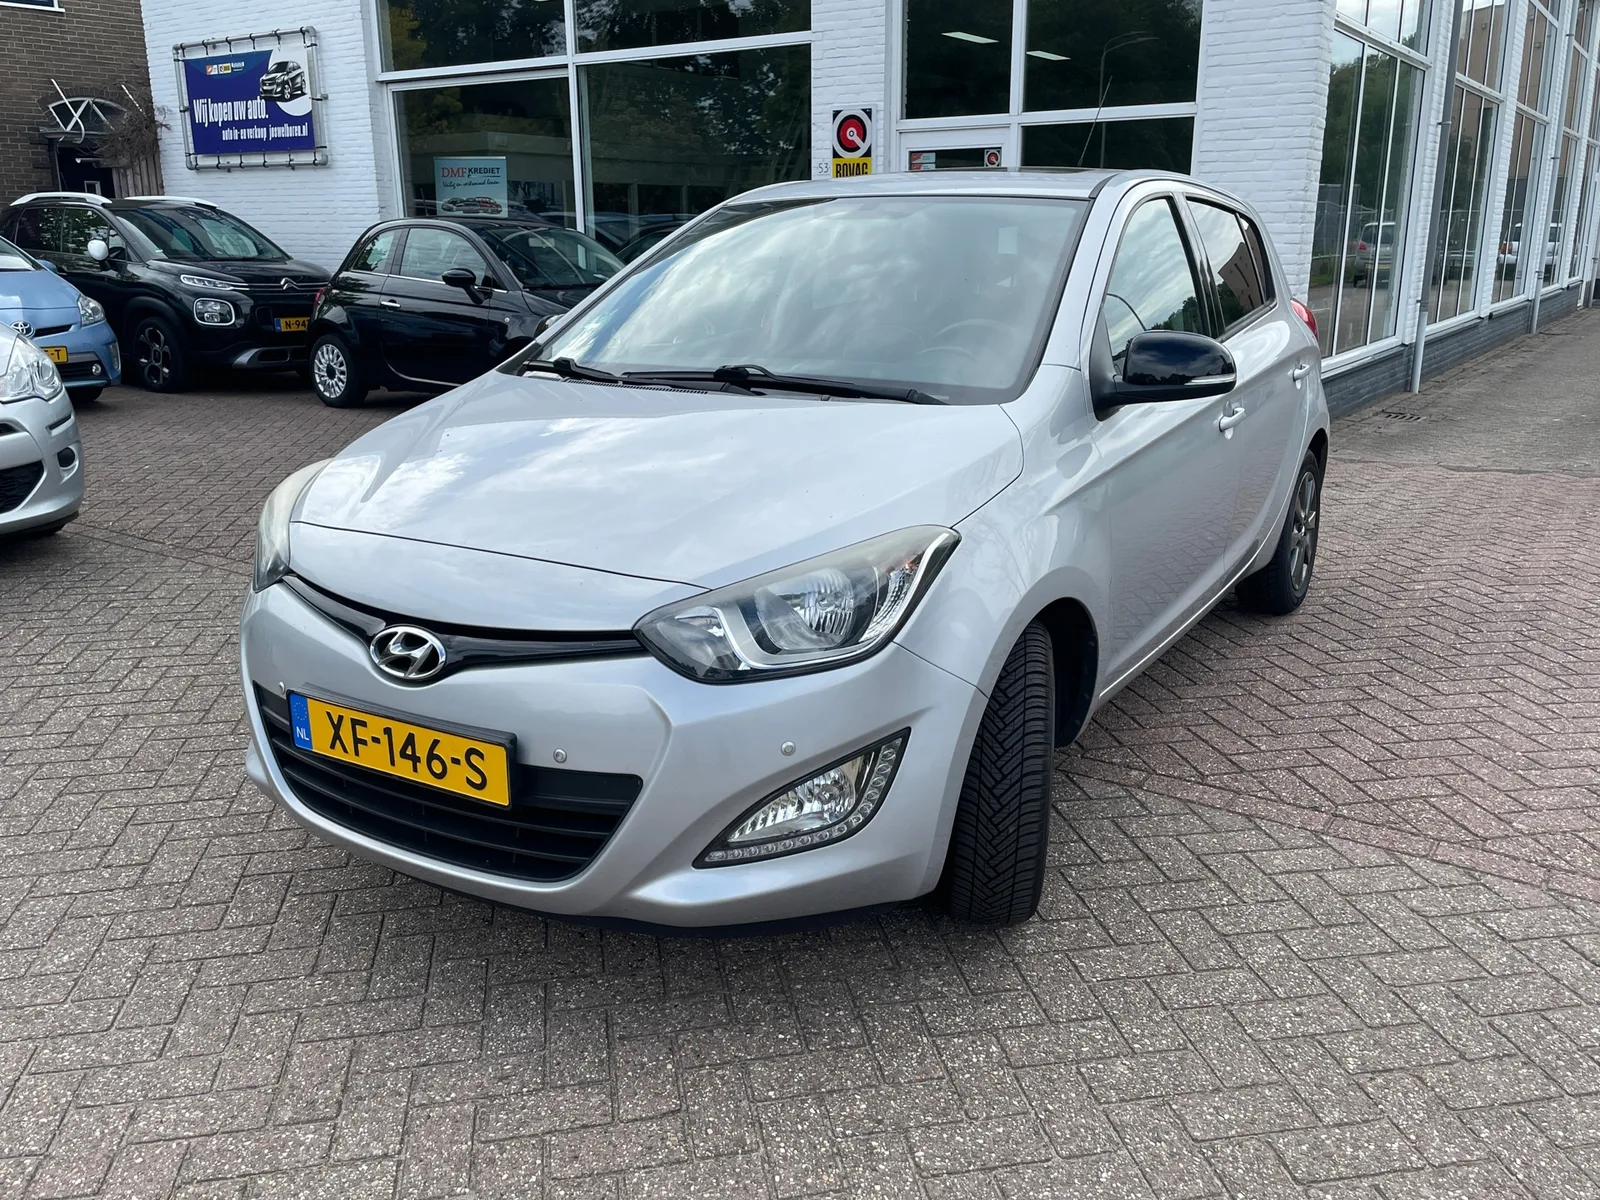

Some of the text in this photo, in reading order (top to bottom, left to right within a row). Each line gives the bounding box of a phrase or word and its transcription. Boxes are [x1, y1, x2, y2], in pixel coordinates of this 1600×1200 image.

[193, 96, 268, 127] Wij kopen uw auto.
[222, 128, 232, 140] auto
[240, 128, 246, 139] en
[247, 125, 267, 141] verkoop
[441, 167, 467, 178] DMF
[296, 726, 310, 741] NL
[325, 710, 488, 791] XF-146-S
